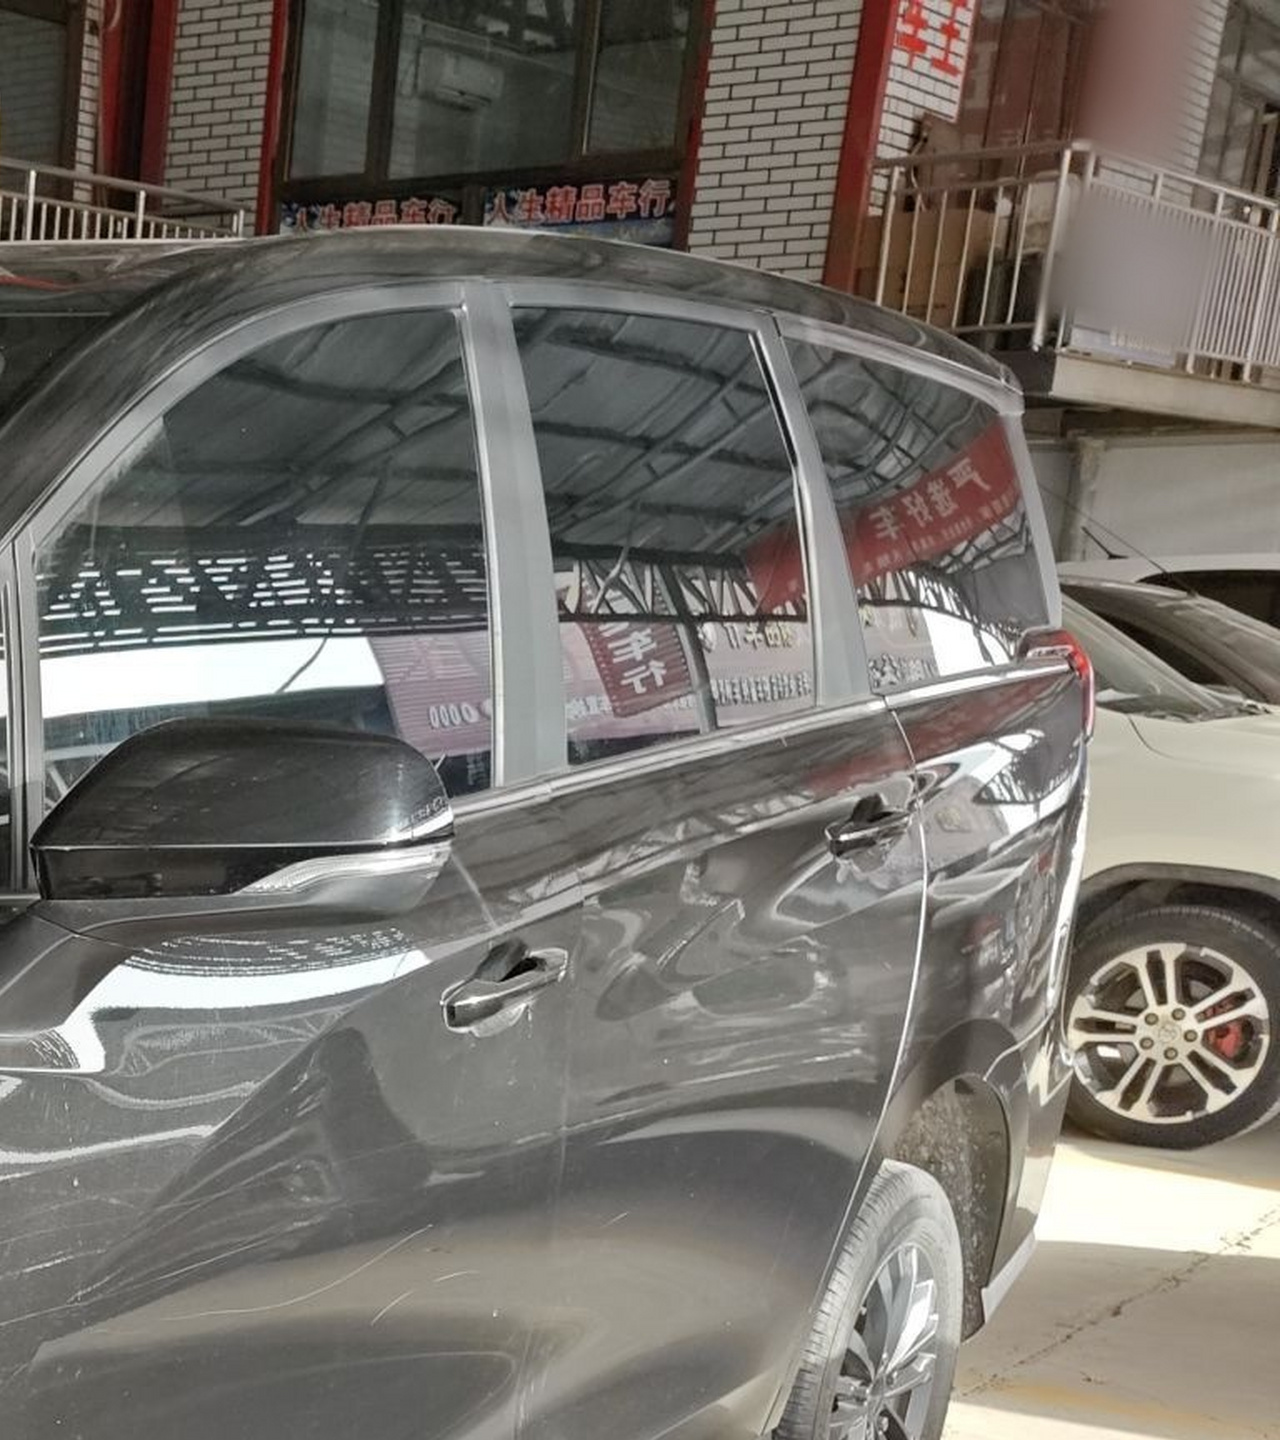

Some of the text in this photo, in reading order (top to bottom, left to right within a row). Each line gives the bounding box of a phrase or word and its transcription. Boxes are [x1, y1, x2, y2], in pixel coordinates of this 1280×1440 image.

[490, 178, 671, 224] 人生精品车行
